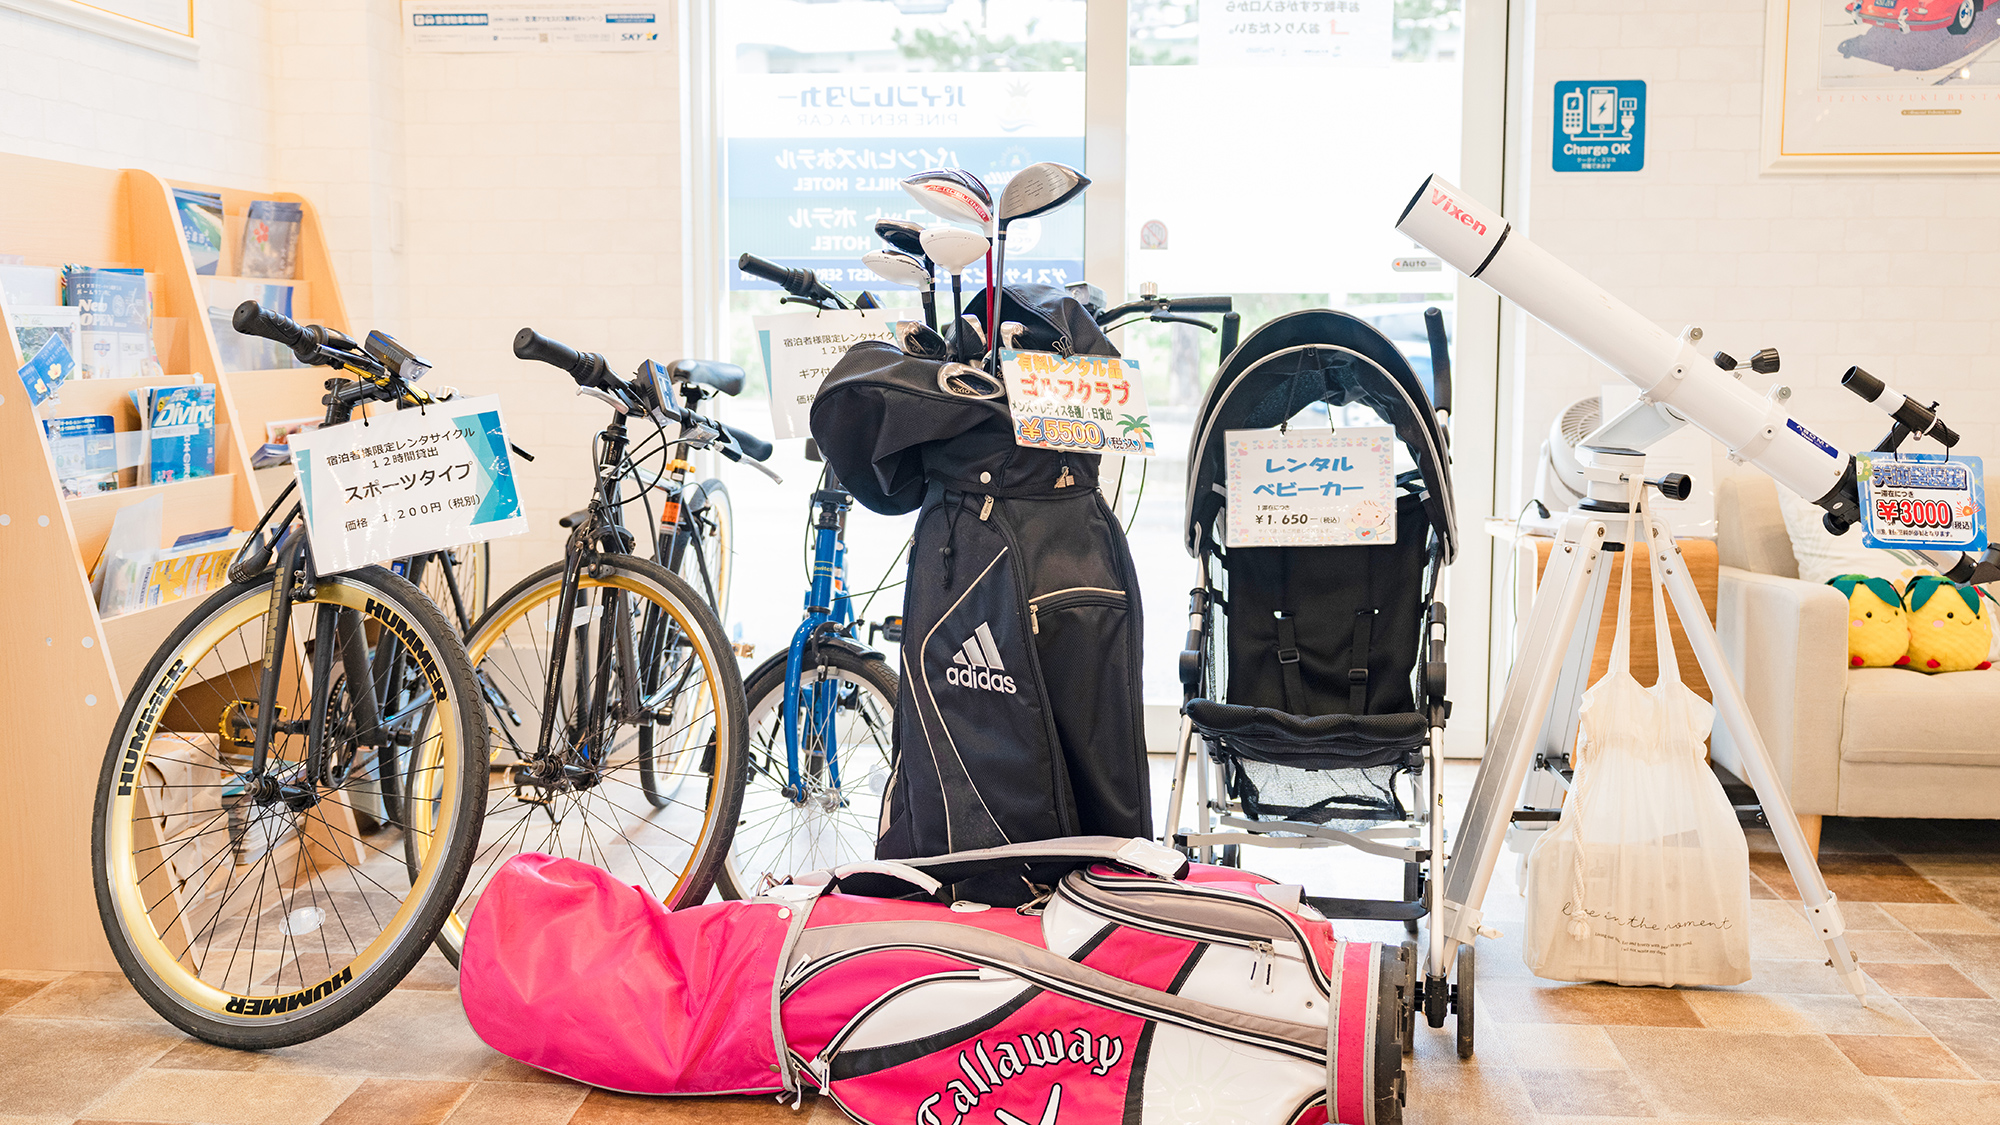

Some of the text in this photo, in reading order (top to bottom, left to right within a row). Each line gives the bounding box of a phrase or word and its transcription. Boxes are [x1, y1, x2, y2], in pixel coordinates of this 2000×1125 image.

[620, 32, 643, 41] SKY
[1876, 94, 1938, 102] SUZUKI
[1947, 93, 1988, 101] BEST
[1563, 143, 1631, 156] Charge OK
[1431, 188, 1487, 236] Vixen
[79, 299, 108, 312] New
[80, 313, 114, 326] OPEN
[783, 330, 895, 348] 宿泊者様限定レンタサイク
[799, 367, 833, 380] ギア付
[1016, 353, 1124, 379] 有料レンタル品
[1020, 373, 1131, 406] ゴルフクラブ
[154, 401, 214, 429] Diving
[1019, 416, 1104, 447] ¥5500
[326, 427, 475, 466] 宿泊者様限定レンタサイクル
[1265, 456, 1354, 473] レンタル
[344, 460, 473, 504] スポーツタイプ
[1253, 481, 1364, 497] ベビーカー
[344, 517, 368, 532] 価格
[1878, 500, 1950, 526] ¥3000
[263, 567, 284, 670] HUMMER
[365, 598, 448, 703] HUMMER
[946, 664, 1017, 694] adidas
[115, 656, 188, 797] HUMMER
[1627, 917, 1660, 931] the
[224, 965, 353, 1016] HUMMER
[916, 1027, 1123, 1125] Callaway
